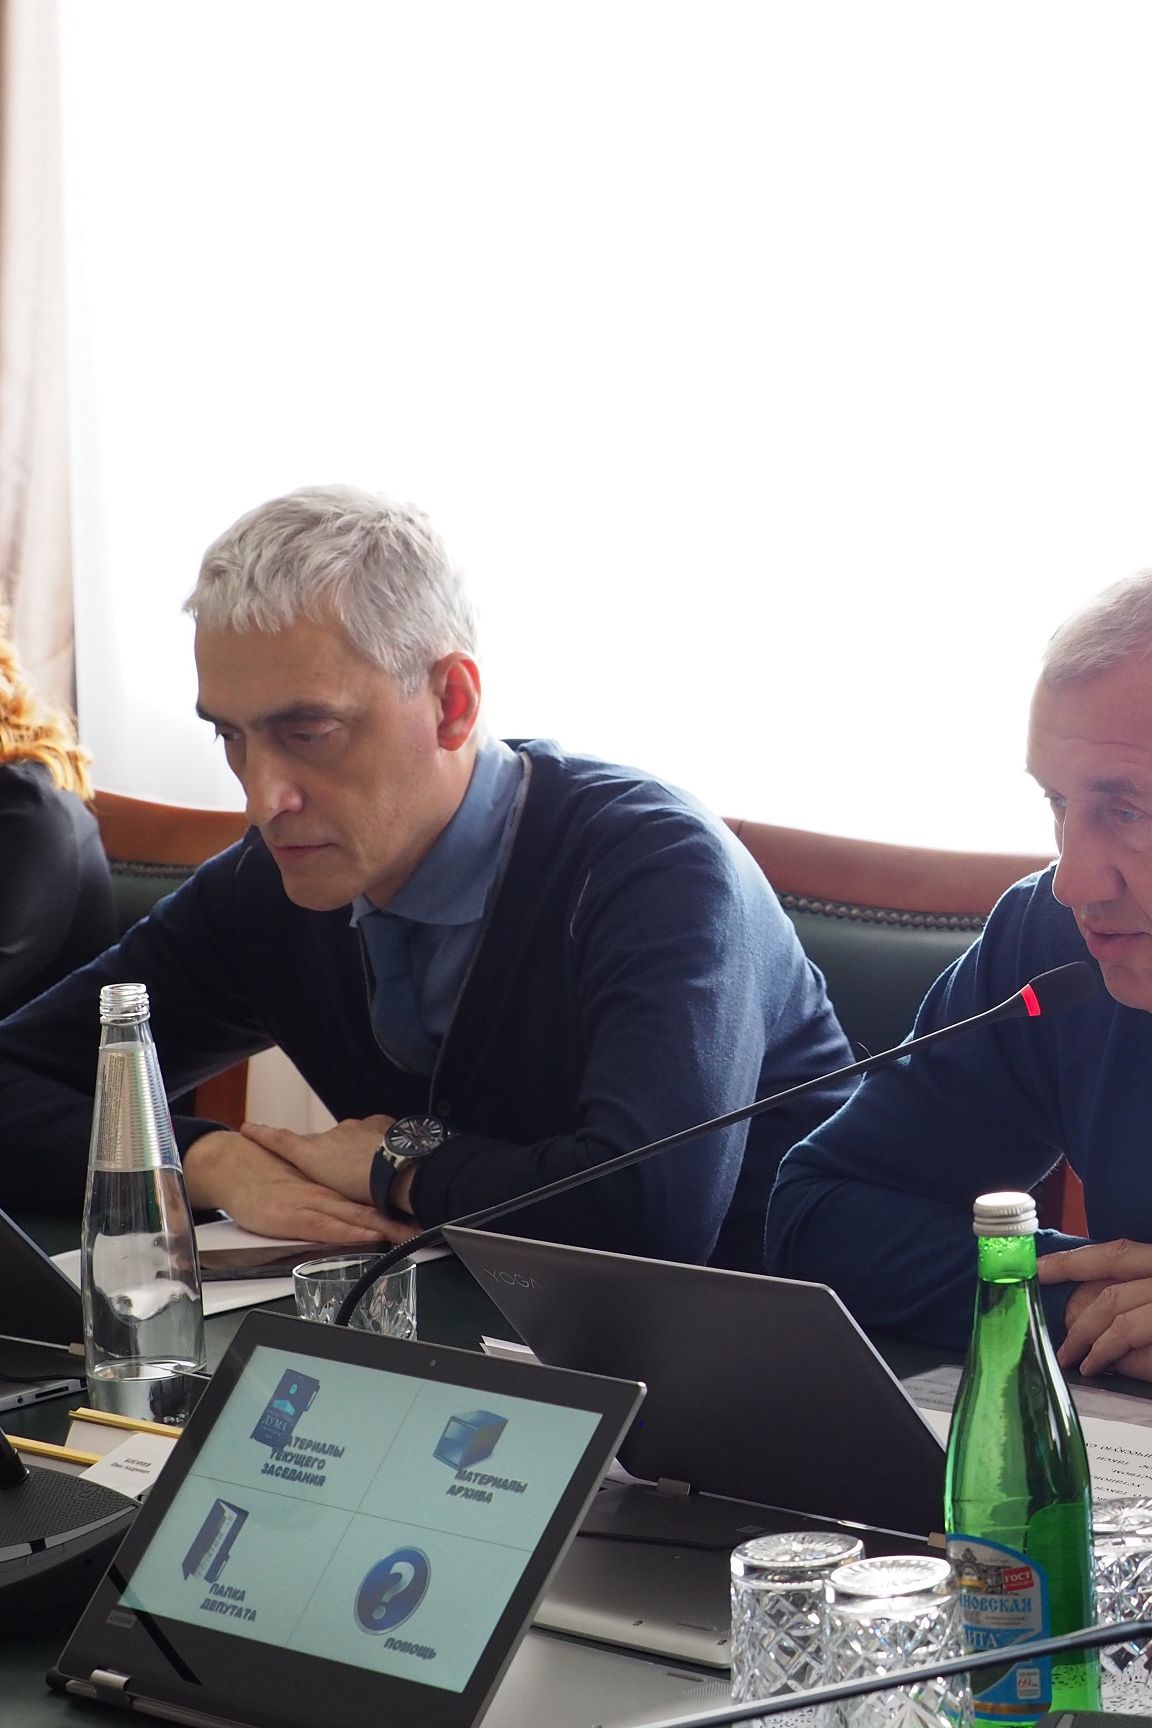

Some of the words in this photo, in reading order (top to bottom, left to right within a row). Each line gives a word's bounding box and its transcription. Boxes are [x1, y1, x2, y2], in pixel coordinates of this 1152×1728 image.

[481, 1265, 544, 1289] YOGA
[284, 1435, 346, 1459] АТЕРИАЛЫ
[261, 1463, 327, 1488] ЗАСЕДАНИЯ
[454, 1469, 529, 1494] МАТЕРИАЛЫ
[446, 1484, 493, 1504] АРХИВА
[1004, 1570, 1031, 1583] ГОСТ
[209, 1583, 246, 1602] ПАПКА
[200, 1598, 257, 1622] ДЕПУТАТА
[383, 1637, 437, 1660] ПОМОЩЬ
